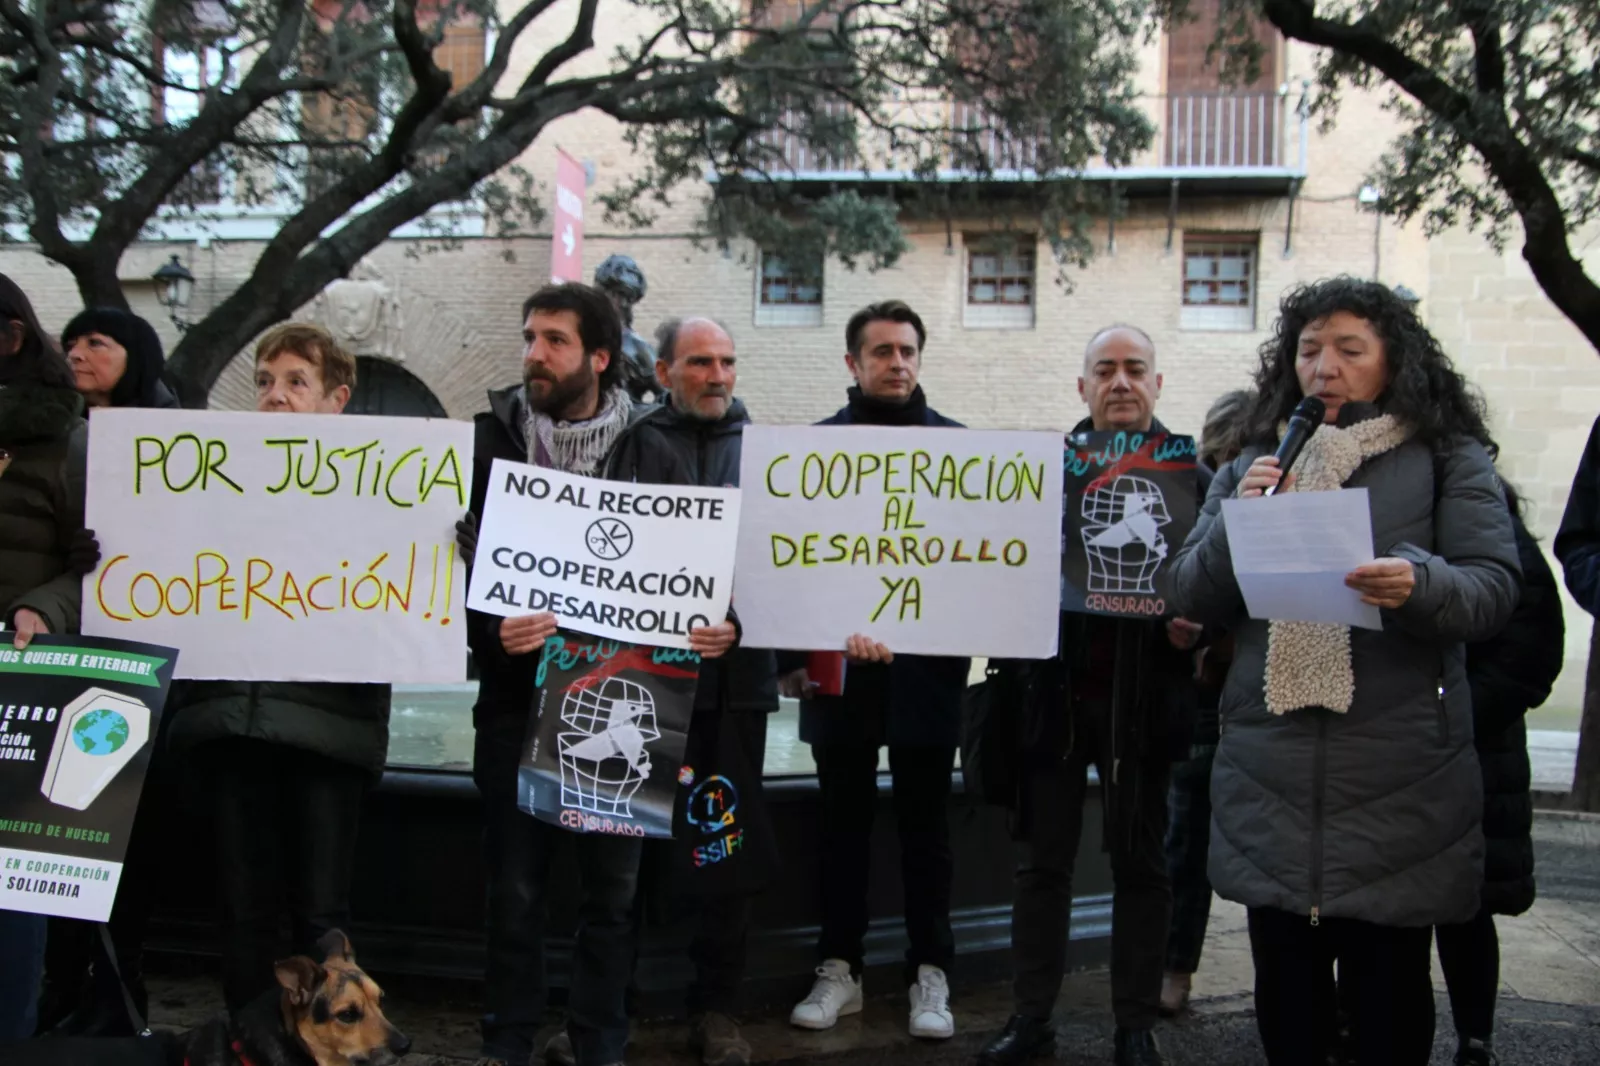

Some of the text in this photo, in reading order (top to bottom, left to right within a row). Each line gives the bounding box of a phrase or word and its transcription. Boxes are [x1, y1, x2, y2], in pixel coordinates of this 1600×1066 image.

[134, 433, 244, 494] POR
[504, 472, 724, 520] NO AL RECORTE
[883, 496, 925, 531] AL
[771, 533, 1028, 567] DESARROLLO
[491, 547, 715, 599] COOPERACIÓN
[485, 581, 710, 636] AL DESARROLLO
[870, 576, 921, 622] YA
[1085, 594, 1165, 616] CENSURADO
[23, 651, 78, 666] QUIEREN
[80, 654, 152, 675] ENTERRAR!
[0, 732, 31, 747] CIÓN
[46, 825, 61, 838] DE
[65, 827, 110, 844] HUESCA
[559, 810, 645, 837] CENSURADO
[5, 857, 110, 882] EN COOPERACIÓN
[7, 876, 80, 898] SOLIDARIA
